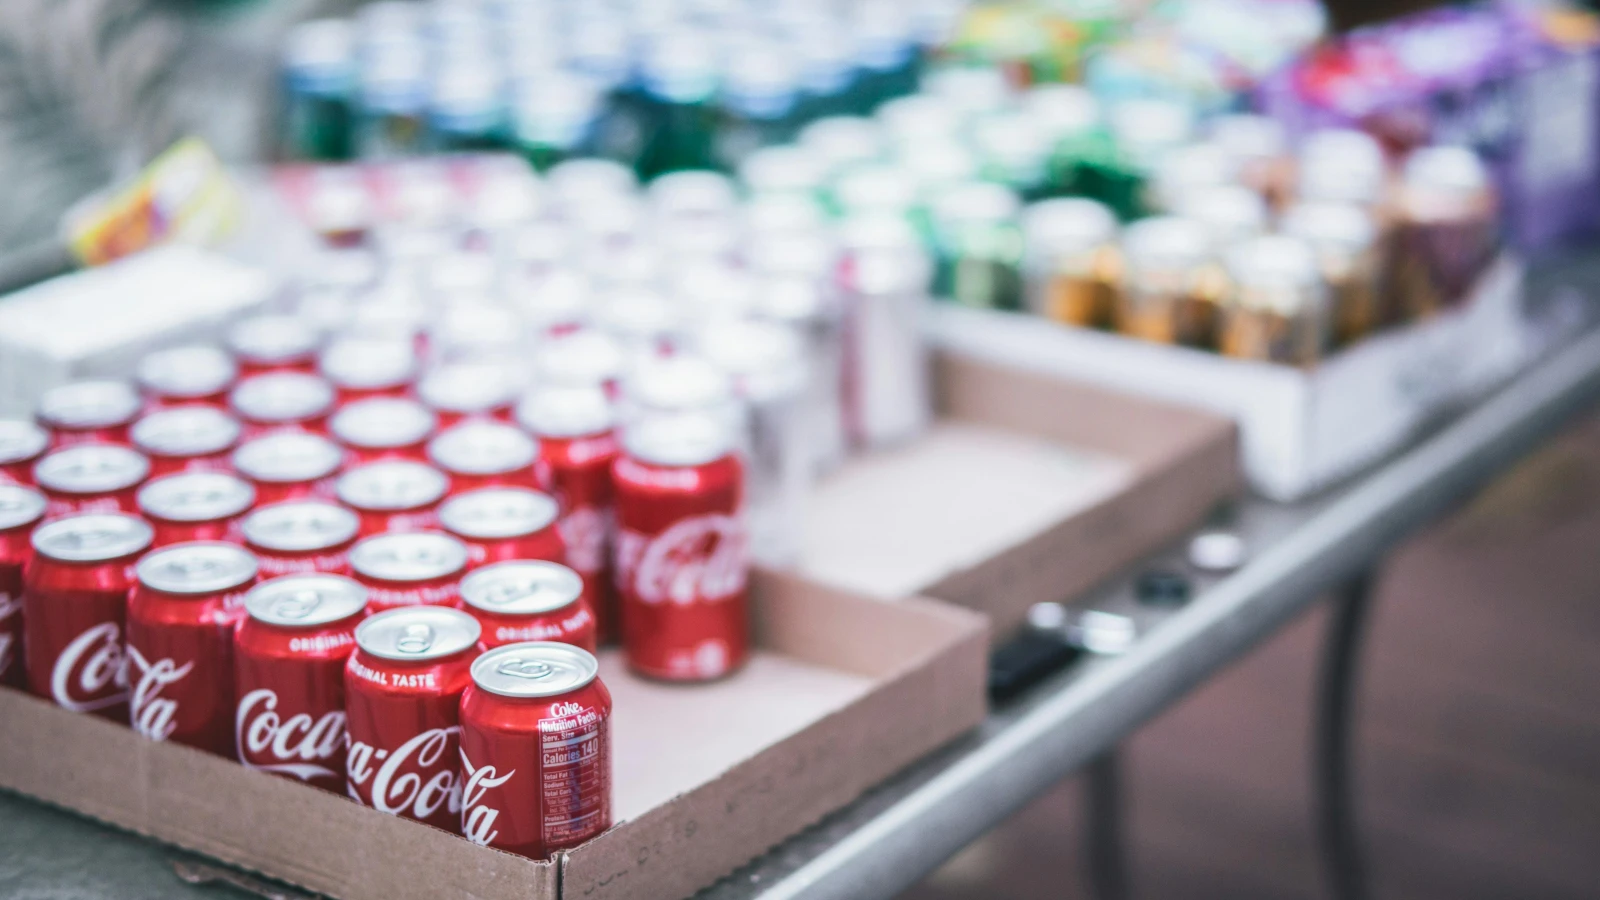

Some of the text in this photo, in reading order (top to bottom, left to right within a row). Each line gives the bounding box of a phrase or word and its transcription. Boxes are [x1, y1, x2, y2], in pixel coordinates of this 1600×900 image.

[392, 673, 436, 688] TASTE
[541, 711, 597, 732] Nutrition Facts
[236, 689, 348, 780] Coca
[543, 734, 560, 743] Serv.
[561, 731, 575, 740] Size
[543, 750, 580, 764] Calories
[581, 738, 598, 756] 140
